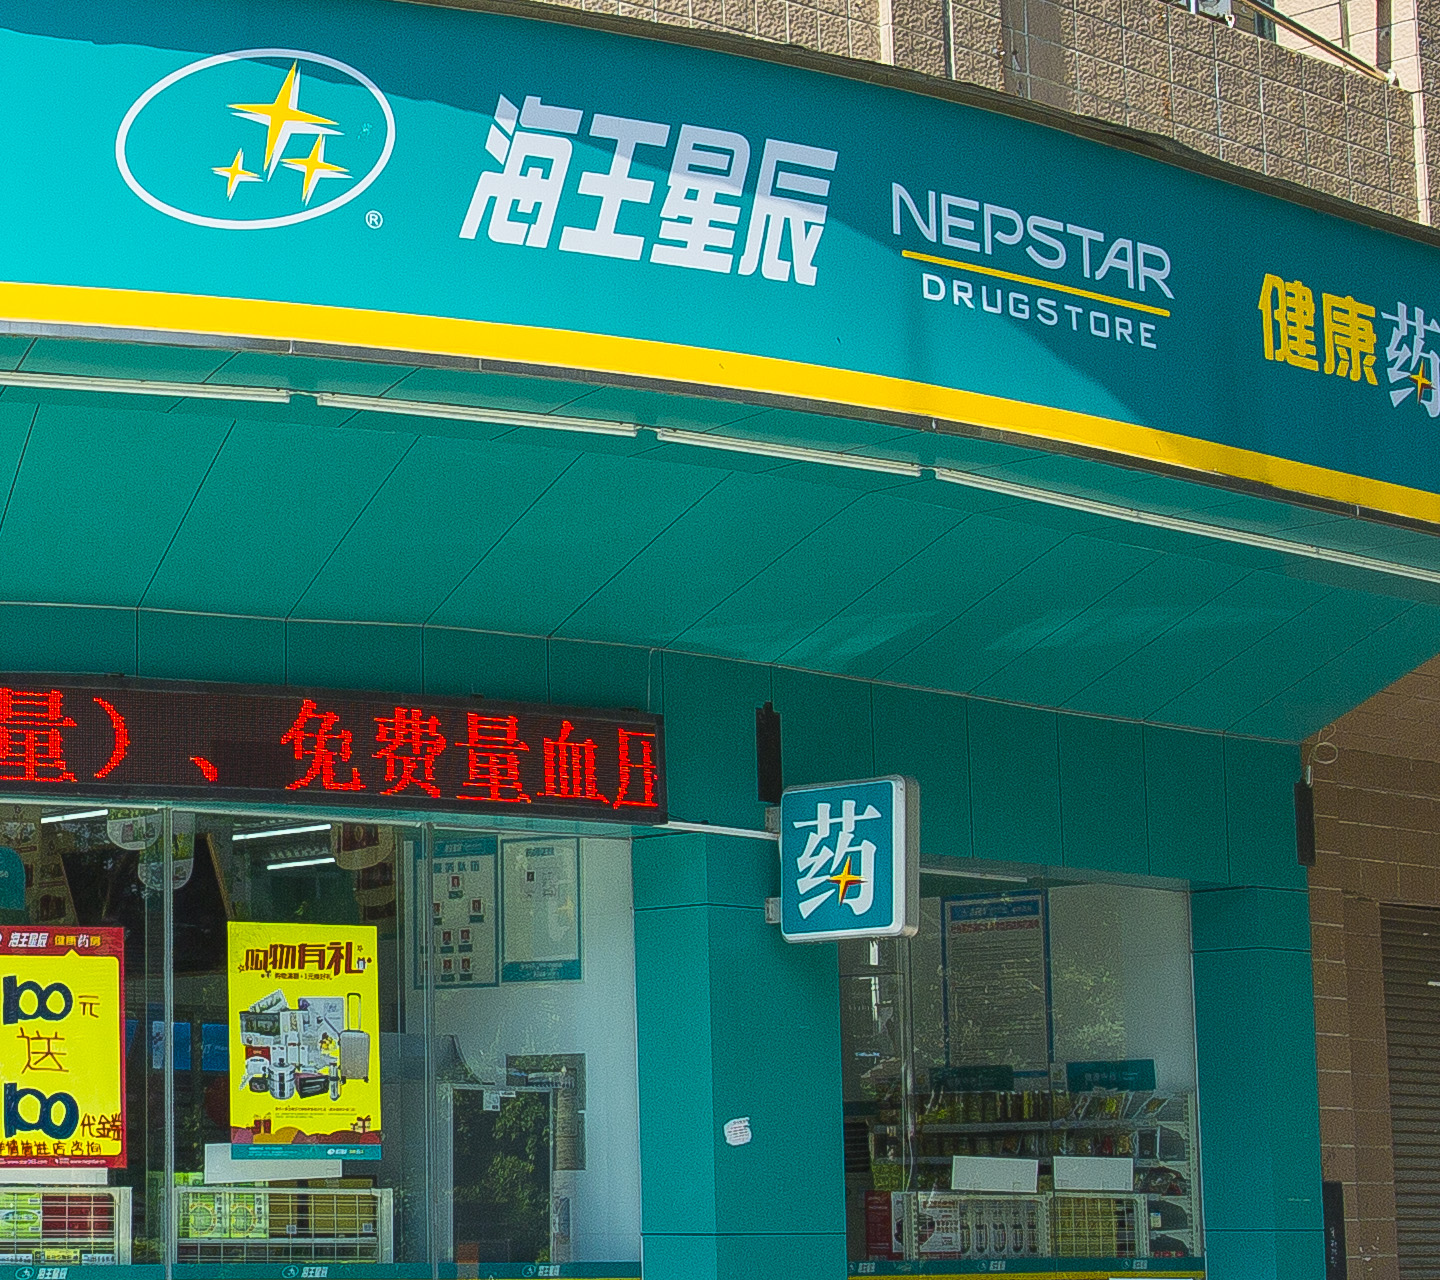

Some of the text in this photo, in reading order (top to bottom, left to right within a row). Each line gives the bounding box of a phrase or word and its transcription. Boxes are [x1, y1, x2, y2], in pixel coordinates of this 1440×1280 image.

[459, 94, 839, 286] 海王星辰
[890, 181, 1175, 300] NEPSTAR
[923, 273, 1158, 350] DRUGSTORE
[793, 799, 881, 920] 药
[245, 942, 364, 976] 购物有礼
[17, 1028, 69, 1074] 送
[4, 1082, 79, 1140] 100
